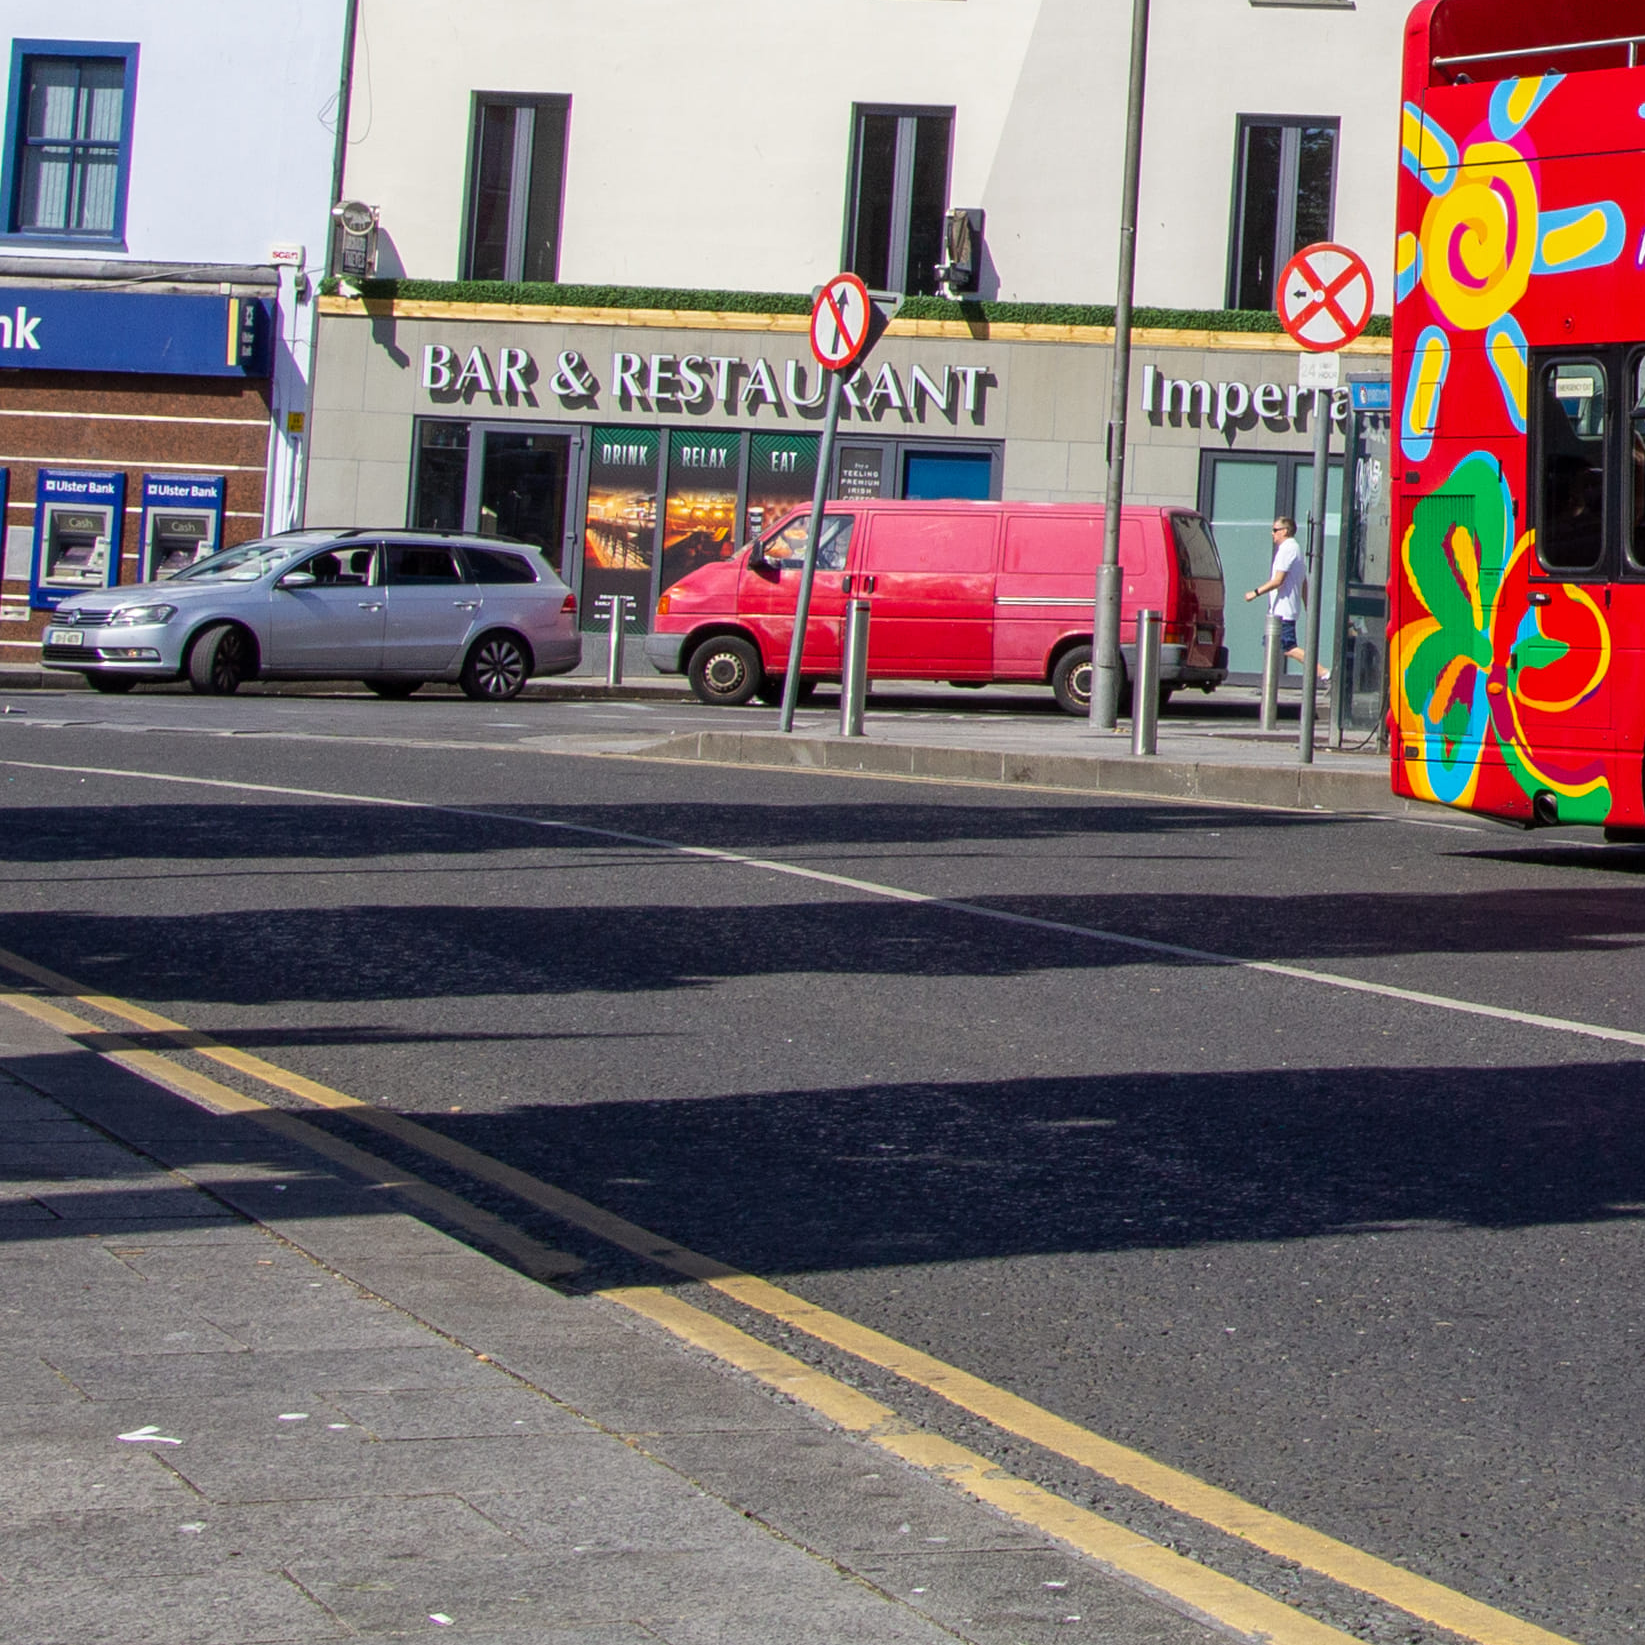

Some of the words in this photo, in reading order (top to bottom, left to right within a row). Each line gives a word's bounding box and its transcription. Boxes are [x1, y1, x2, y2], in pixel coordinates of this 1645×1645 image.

[422, 344, 532, 394] BAR
[549, 350, 592, 397] &
[1142, 364, 1349, 433] Imperia
[602, 444, 648, 467] DRINK
[682, 446, 728, 469] RELAX
[771, 451, 798, 473] EAT
[843, 470, 879, 478] TEELING
[56, 480, 88, 493] Ulster
[90, 482, 115, 494] Bank
[841, 478, 880, 487] PREMIUM
[158, 484, 190, 497] Ulster
[192, 485, 218, 498] Bank
[68, 517, 94, 529] Cash
[171, 521, 196, 533] Cash
